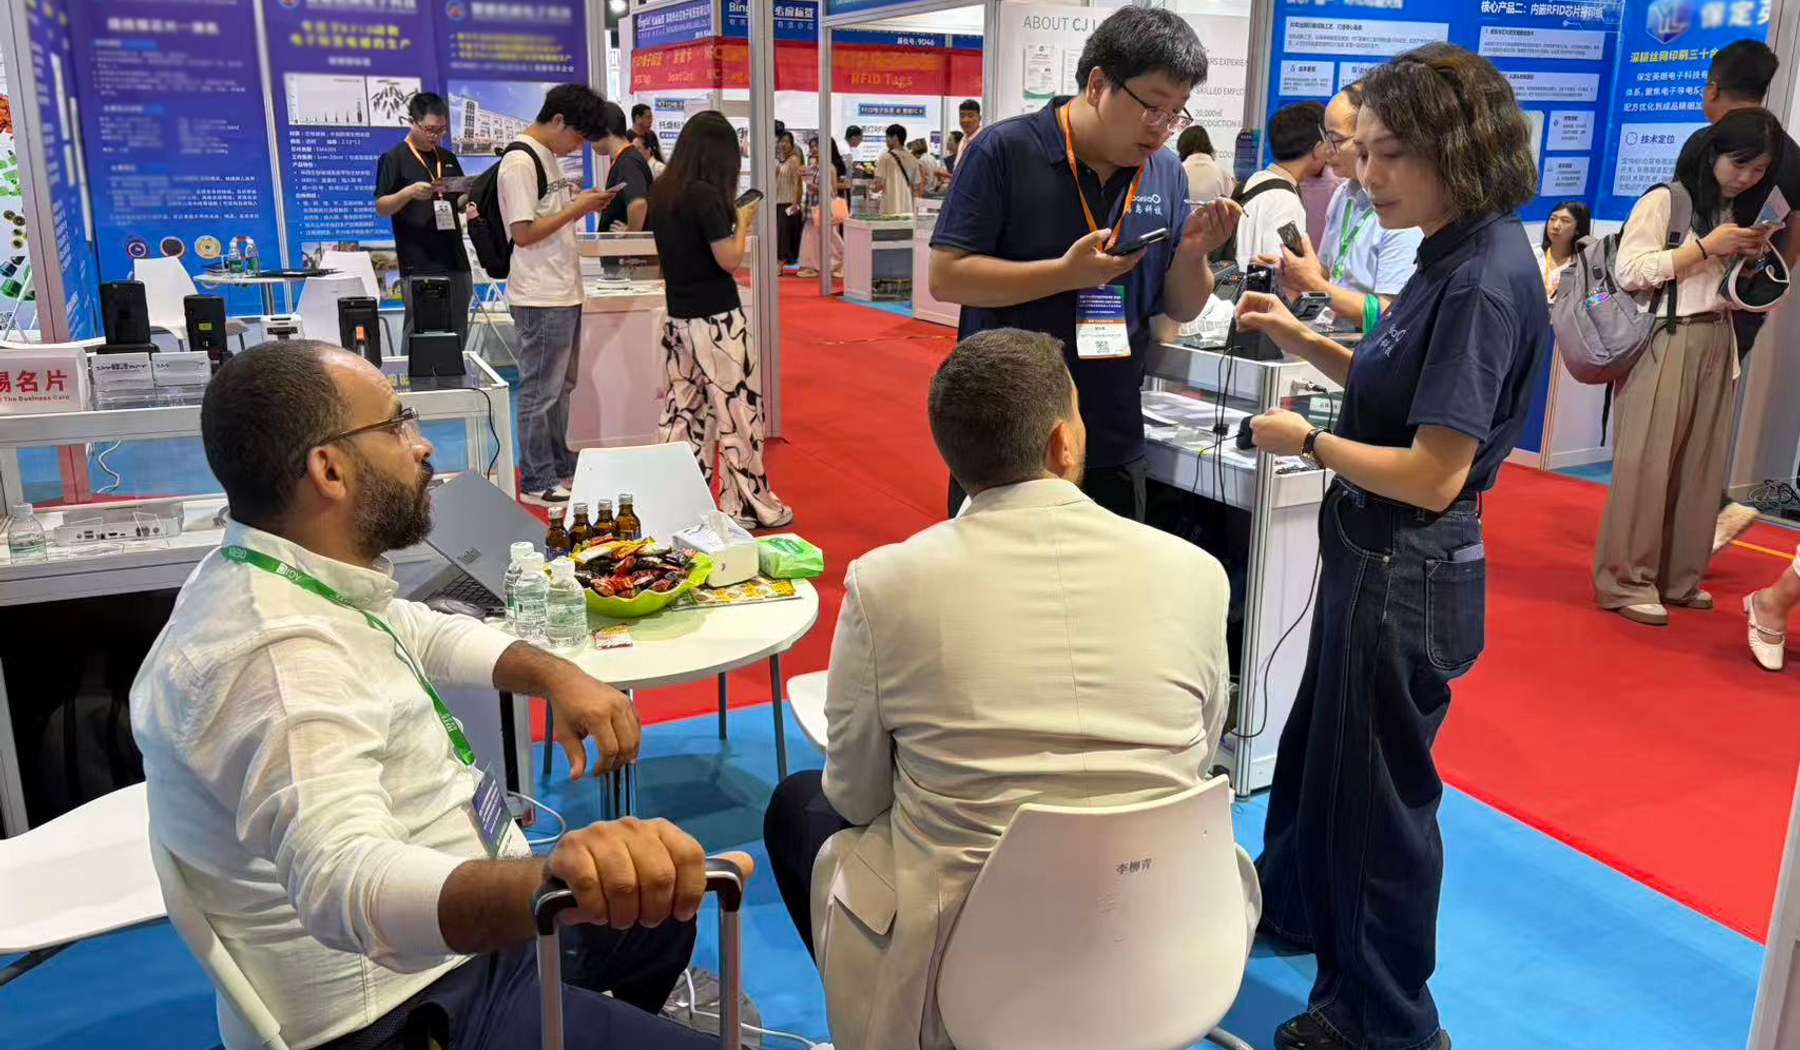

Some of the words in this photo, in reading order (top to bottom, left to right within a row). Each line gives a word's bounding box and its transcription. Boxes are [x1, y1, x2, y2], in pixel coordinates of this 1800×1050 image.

[1023, 15, 1070, 31] ABOUT
[1072, 18, 1091, 33] CJ
[1640, 134, 1676, 144] 技术定位
